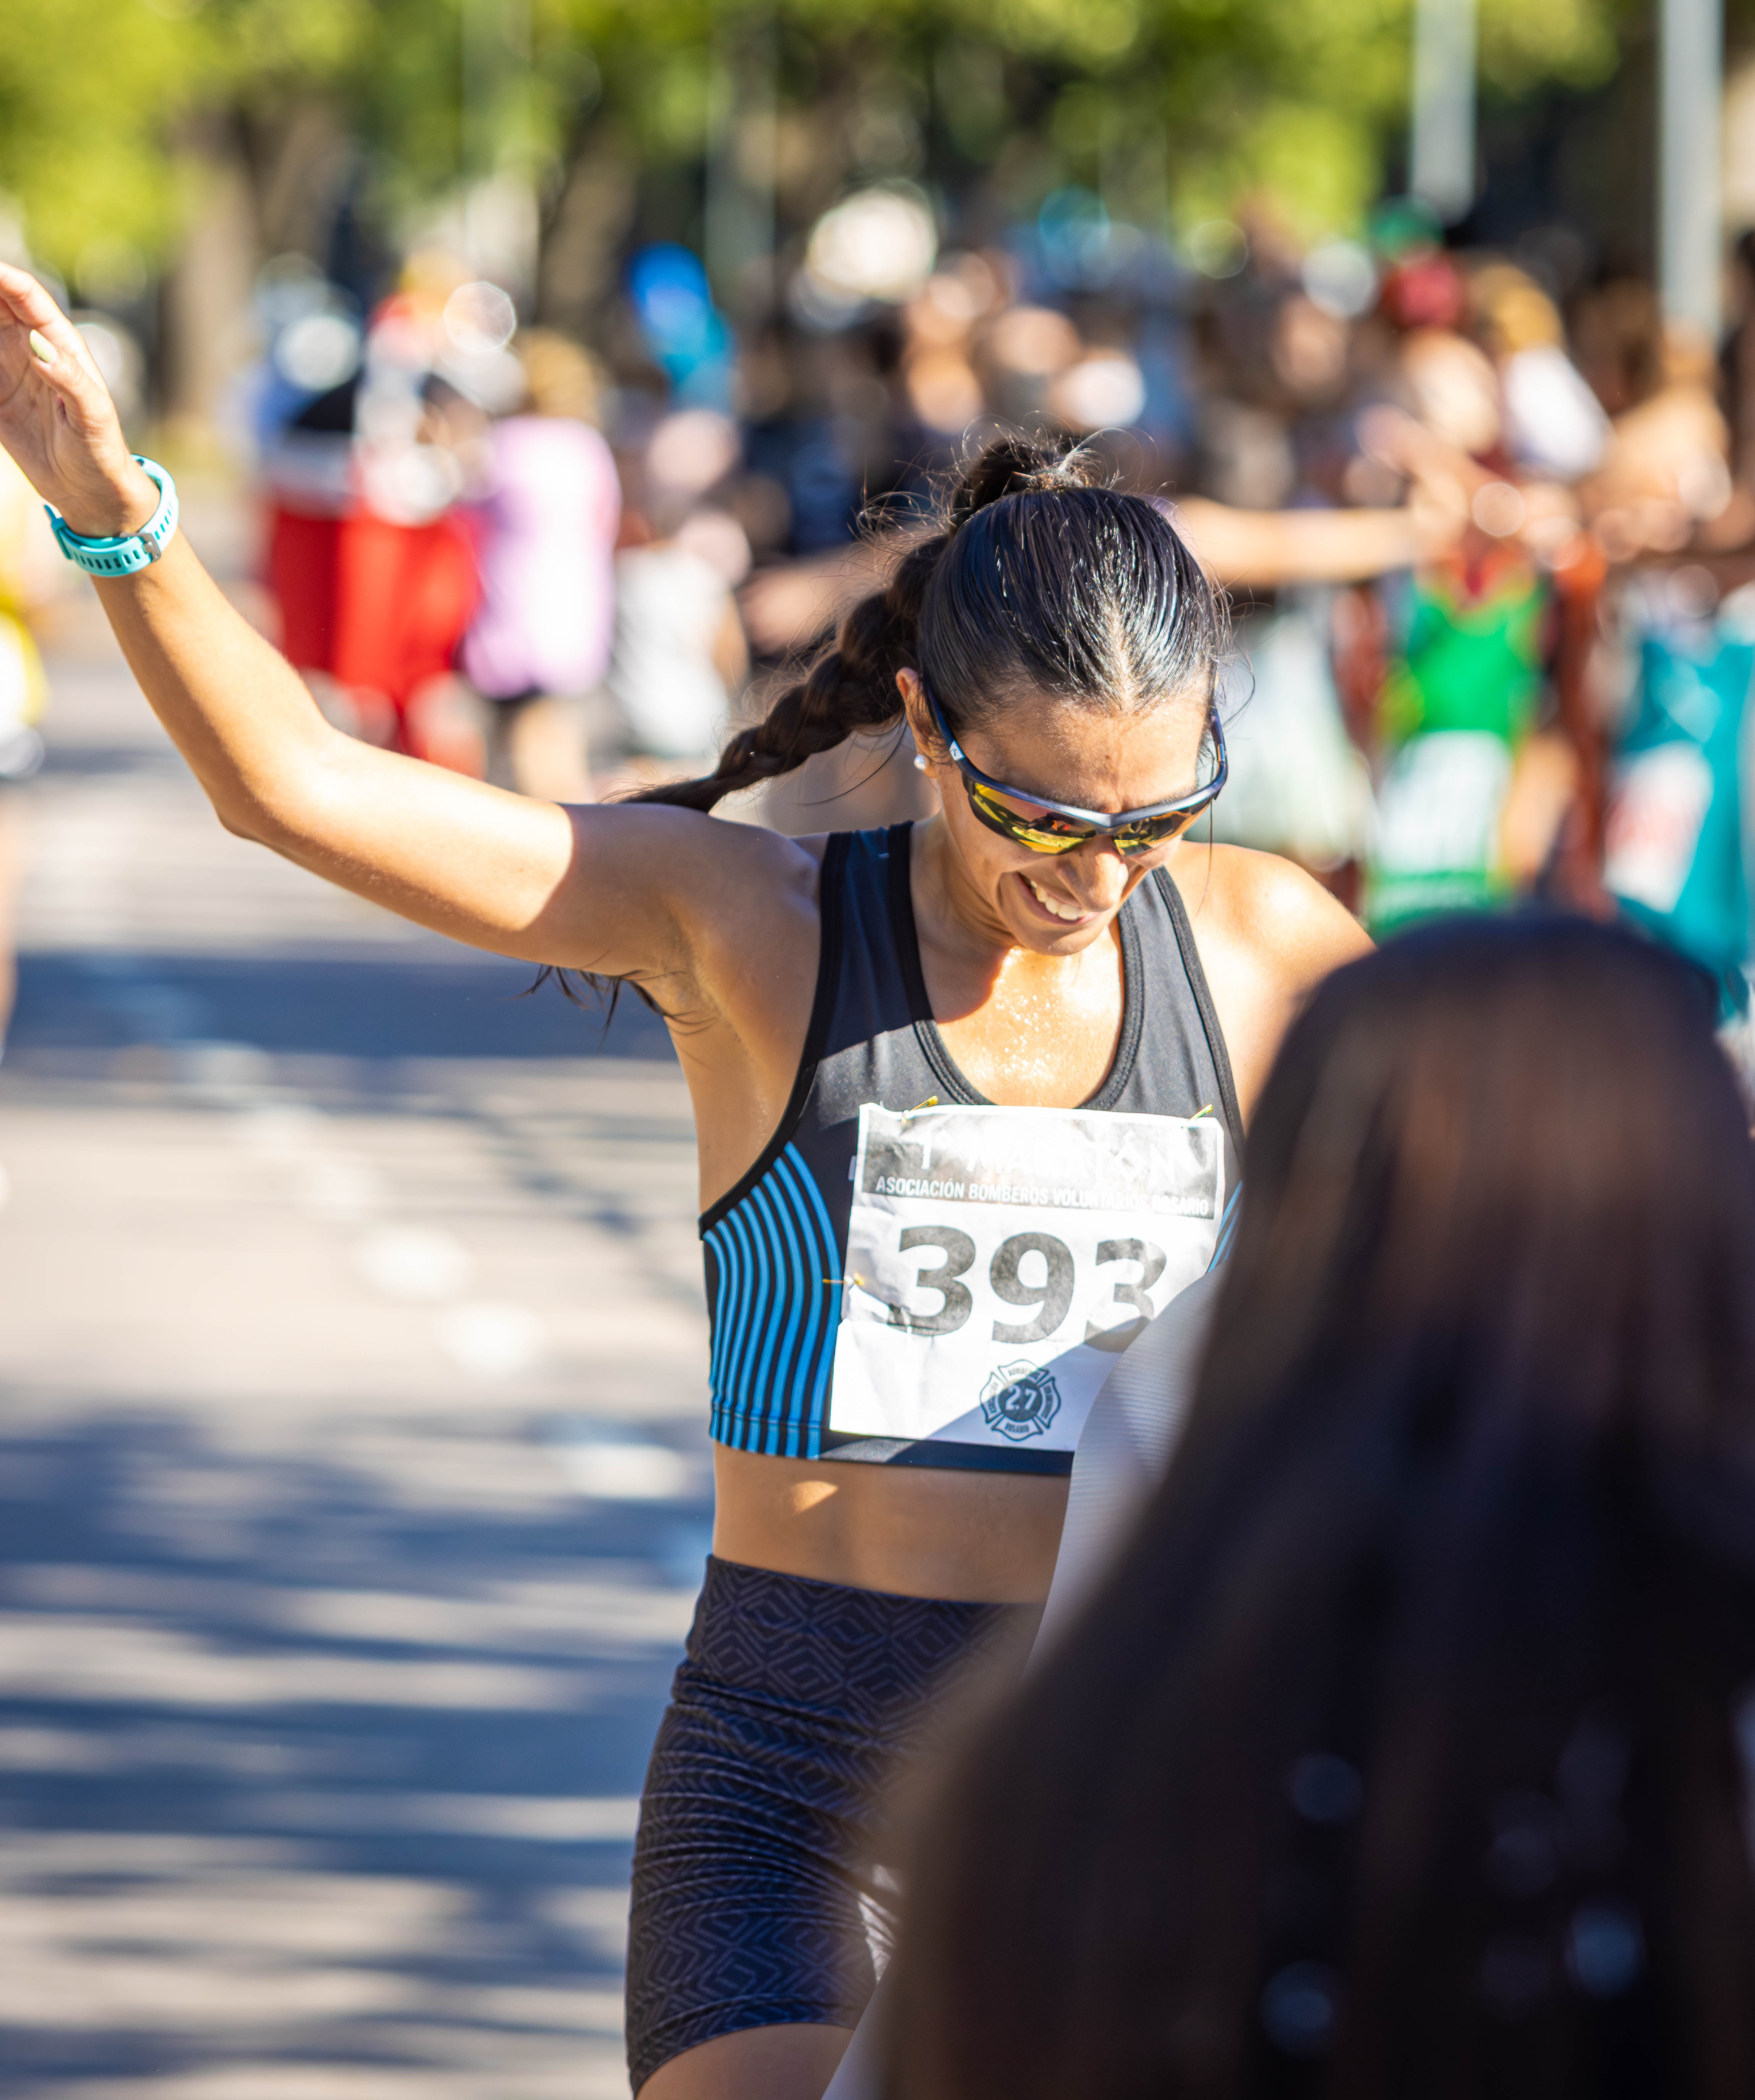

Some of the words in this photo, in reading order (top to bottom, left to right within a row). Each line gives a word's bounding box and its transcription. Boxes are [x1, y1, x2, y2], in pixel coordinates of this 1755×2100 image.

[875, 1175, 965, 1200] ASOCIACIÓN
[968, 1184, 1048, 1205] BOMBEROS
[1052, 1188, 1147, 1212] VOLUNTARIOS
[1152, 1195, 1208, 1216] ROSARIO
[887, 1226, 1166, 1352] 393
[1005, 1383, 1038, 1411] 27
